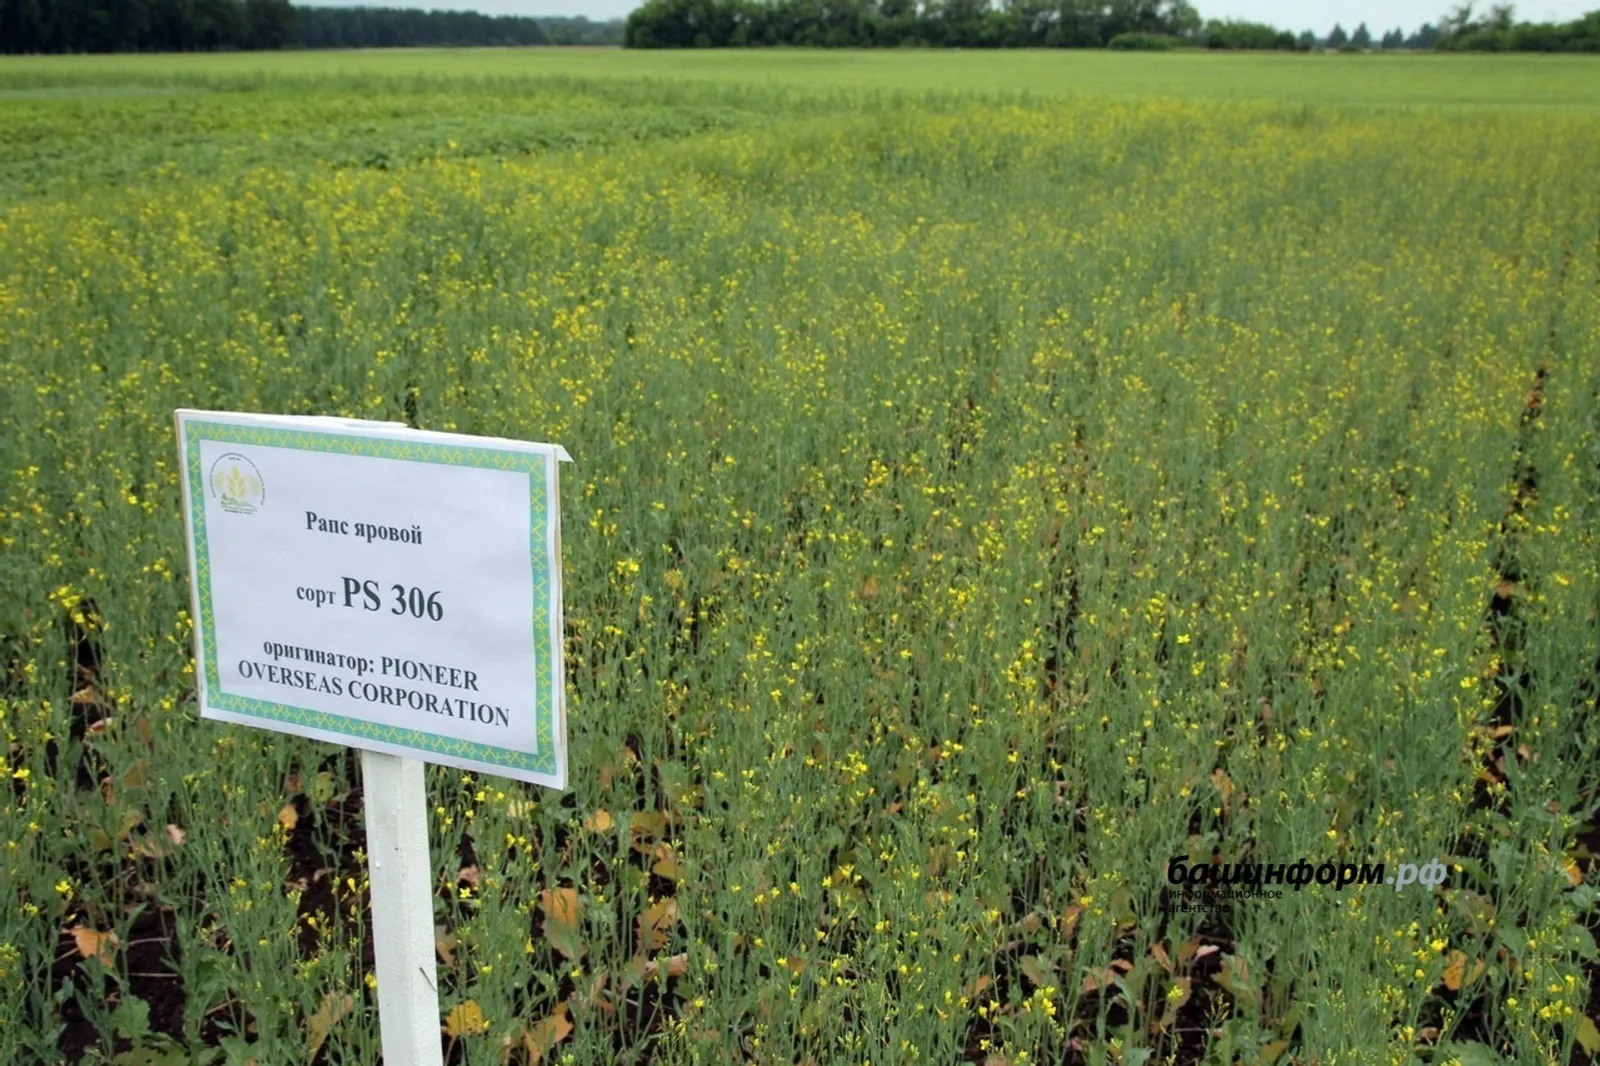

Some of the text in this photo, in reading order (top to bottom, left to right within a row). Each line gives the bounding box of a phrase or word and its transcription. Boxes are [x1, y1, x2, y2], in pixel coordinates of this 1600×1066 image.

[305, 511, 423, 545] Рапс яровой
[296, 576, 444, 622] сорт PS 306
[263, 640, 479, 692] оригинатор: PIONEER
[238, 659, 510, 728] OVERSEAS CORPORATION
